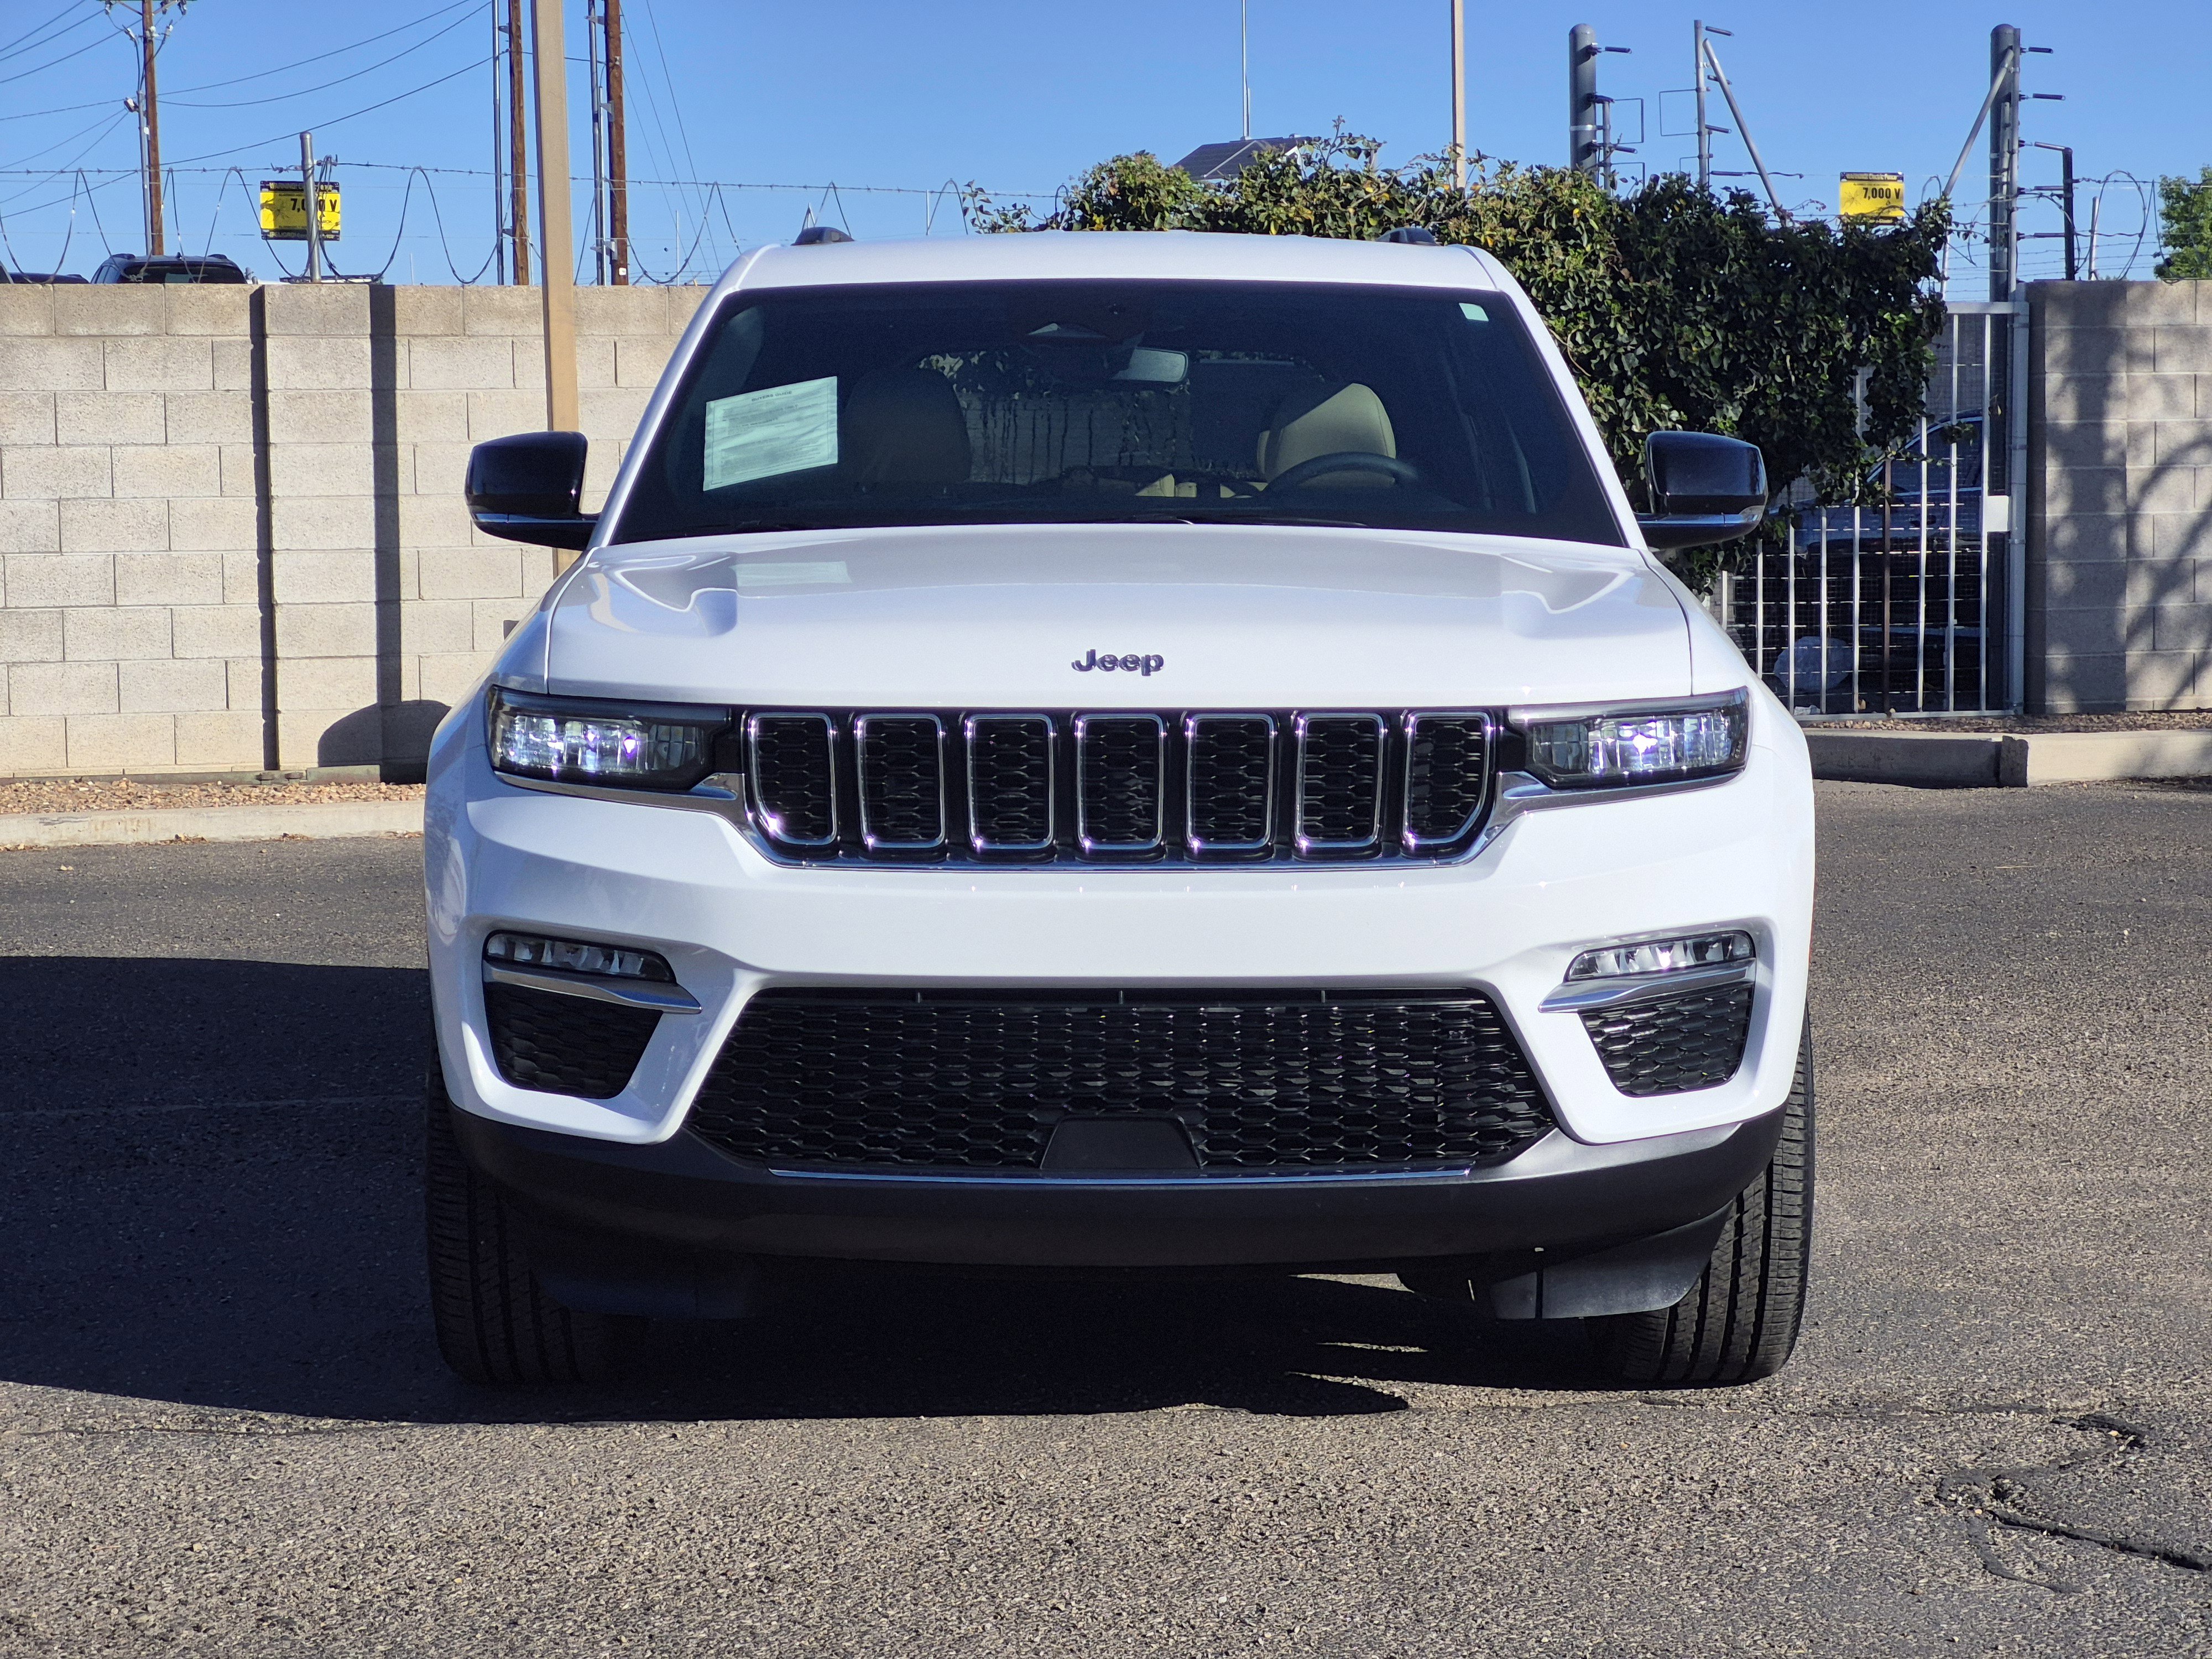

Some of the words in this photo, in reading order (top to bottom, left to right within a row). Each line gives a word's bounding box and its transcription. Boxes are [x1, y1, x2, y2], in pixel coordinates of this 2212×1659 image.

[1863, 187, 1891, 200] 7,000
[1895, 188, 1901, 200] V
[329, 199, 337, 212] V
[1071, 649, 1164, 677] Jeep
